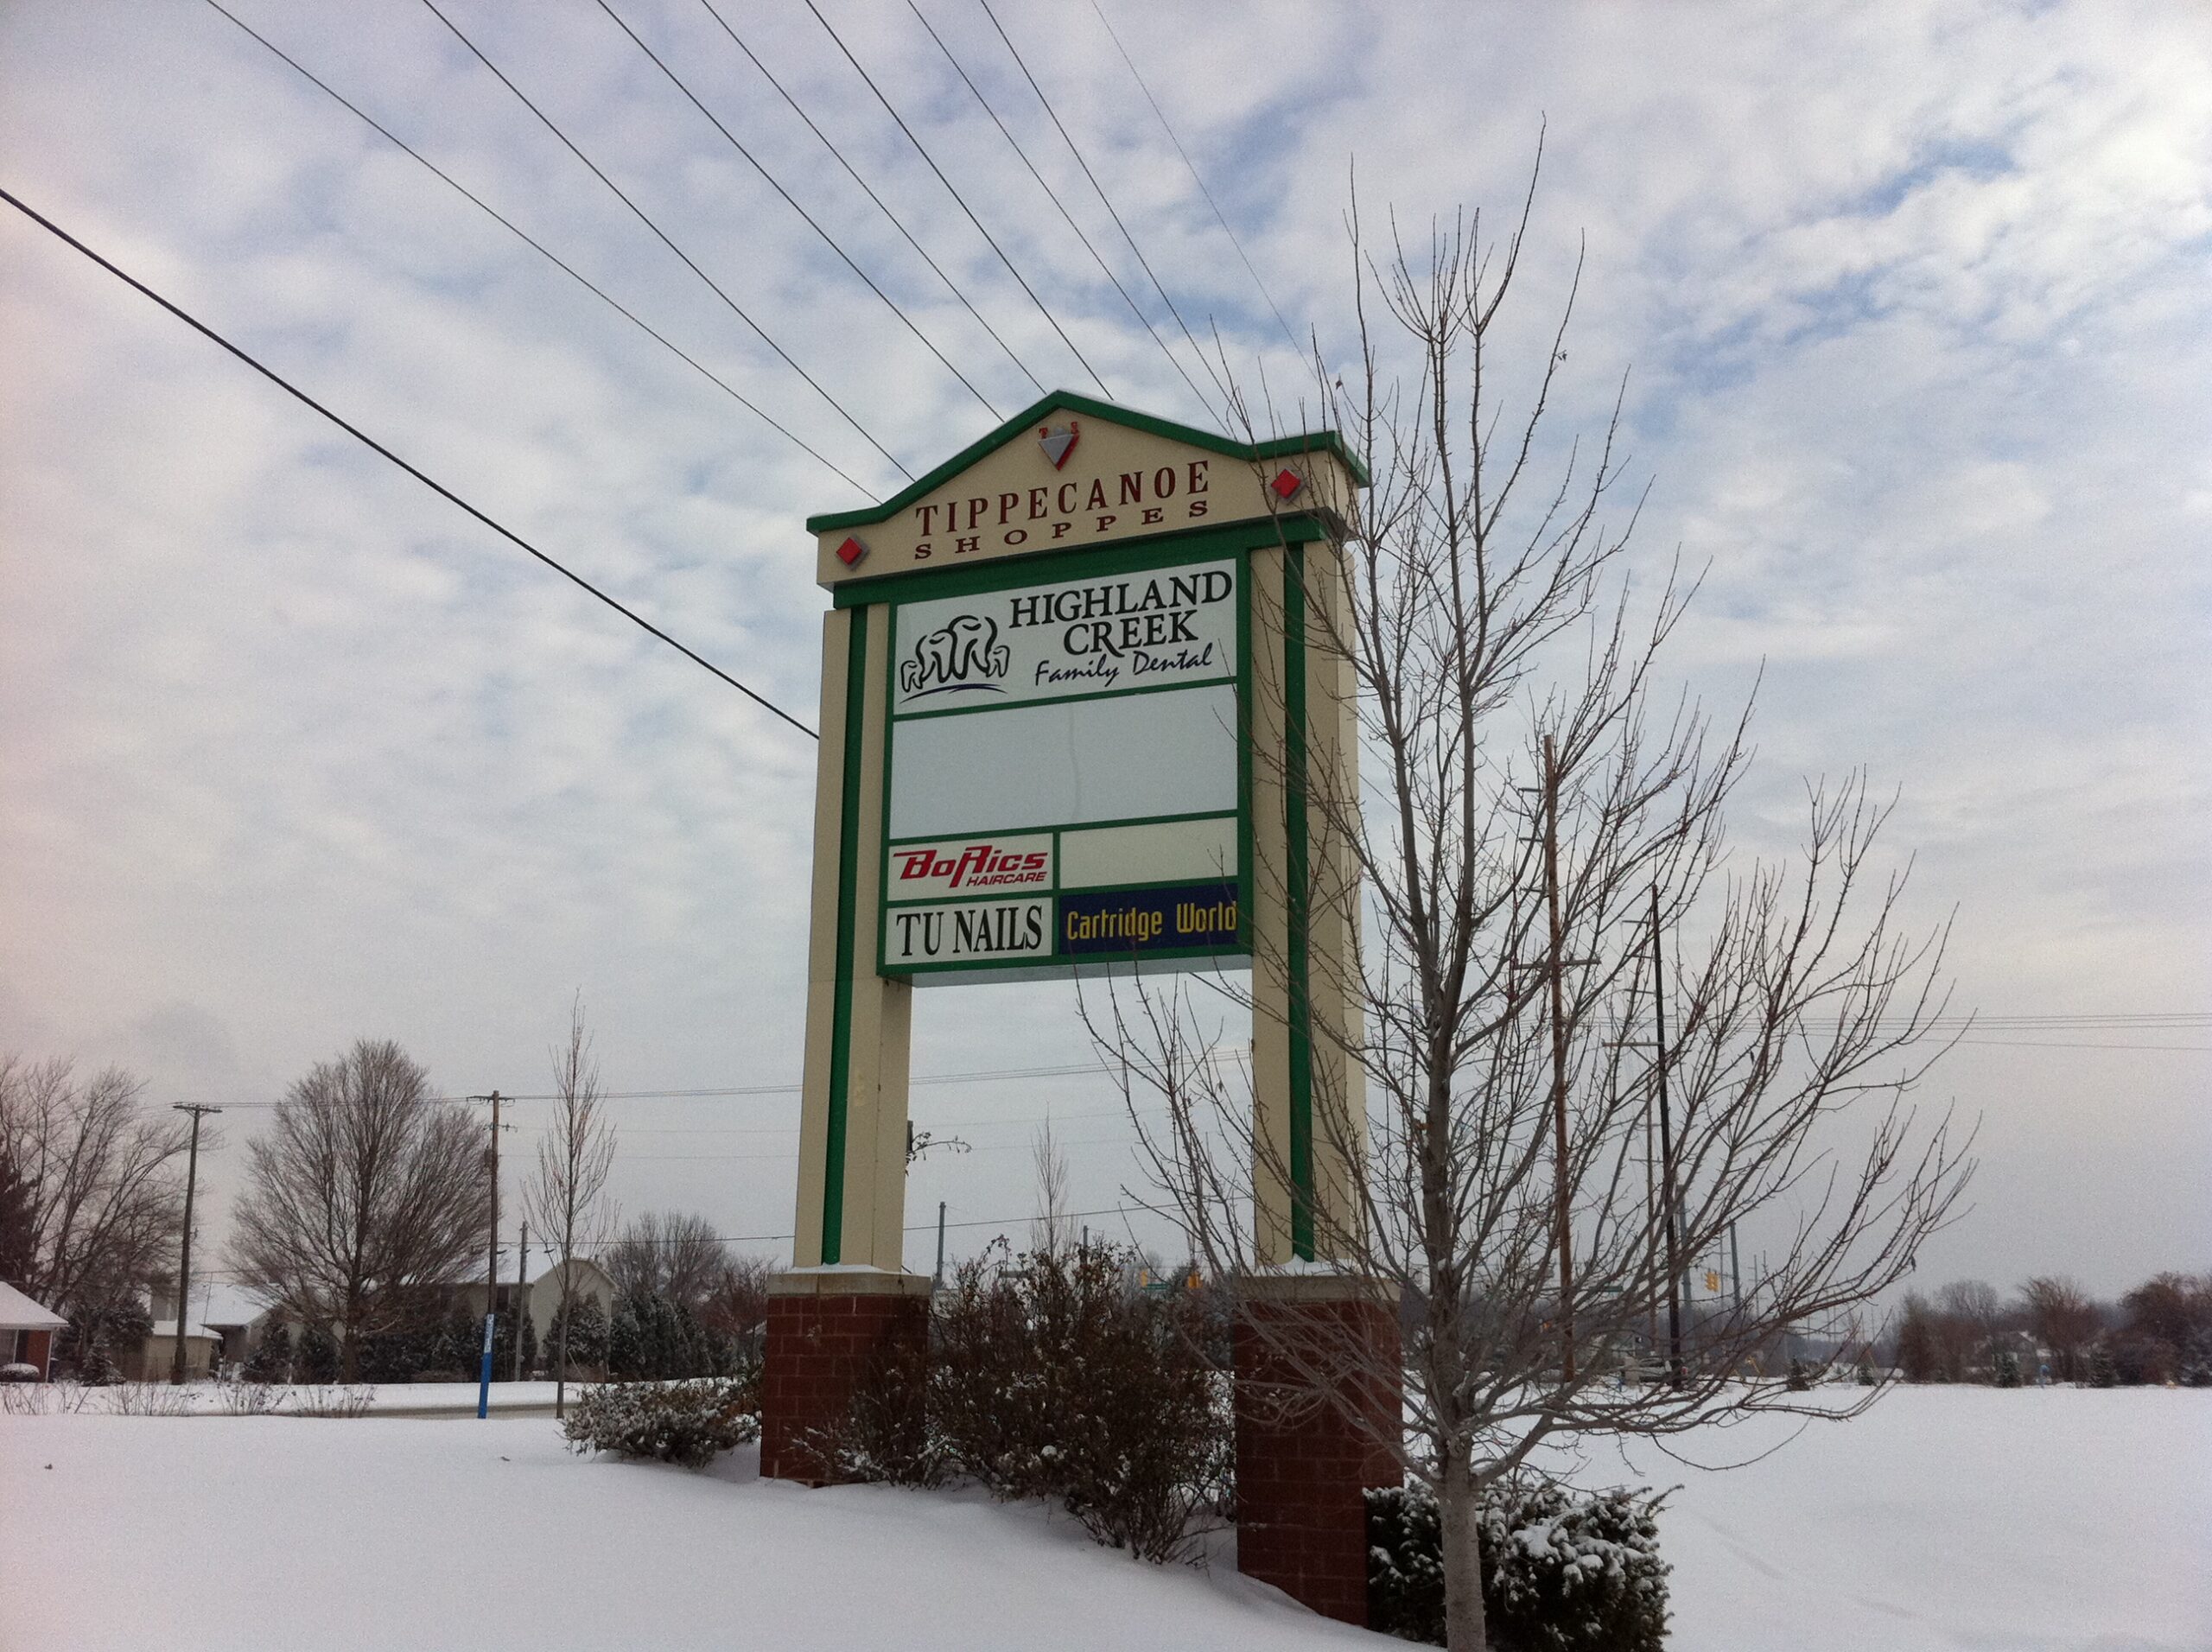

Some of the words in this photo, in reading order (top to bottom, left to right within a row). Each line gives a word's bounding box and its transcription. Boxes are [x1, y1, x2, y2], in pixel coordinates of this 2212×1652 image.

[915, 460, 1210, 537] TIPPECANOE
[914, 499, 1210, 560] SHOPPES
[1008, 570, 1233, 629] HIGHLAND
[1063, 609, 1199, 658] CREEK
[1035, 653, 1120, 688] Family
[1133, 642, 1212, 676] Dental
[893, 844, 1048, 889] BoRics
[966, 871, 1047, 887] HAIRCARE
[896, 912, 944, 956] TU
[952, 905, 1043, 954] NAILS
[1066, 905, 1163, 942] Cartridge
[1175, 899, 1236, 934] World
